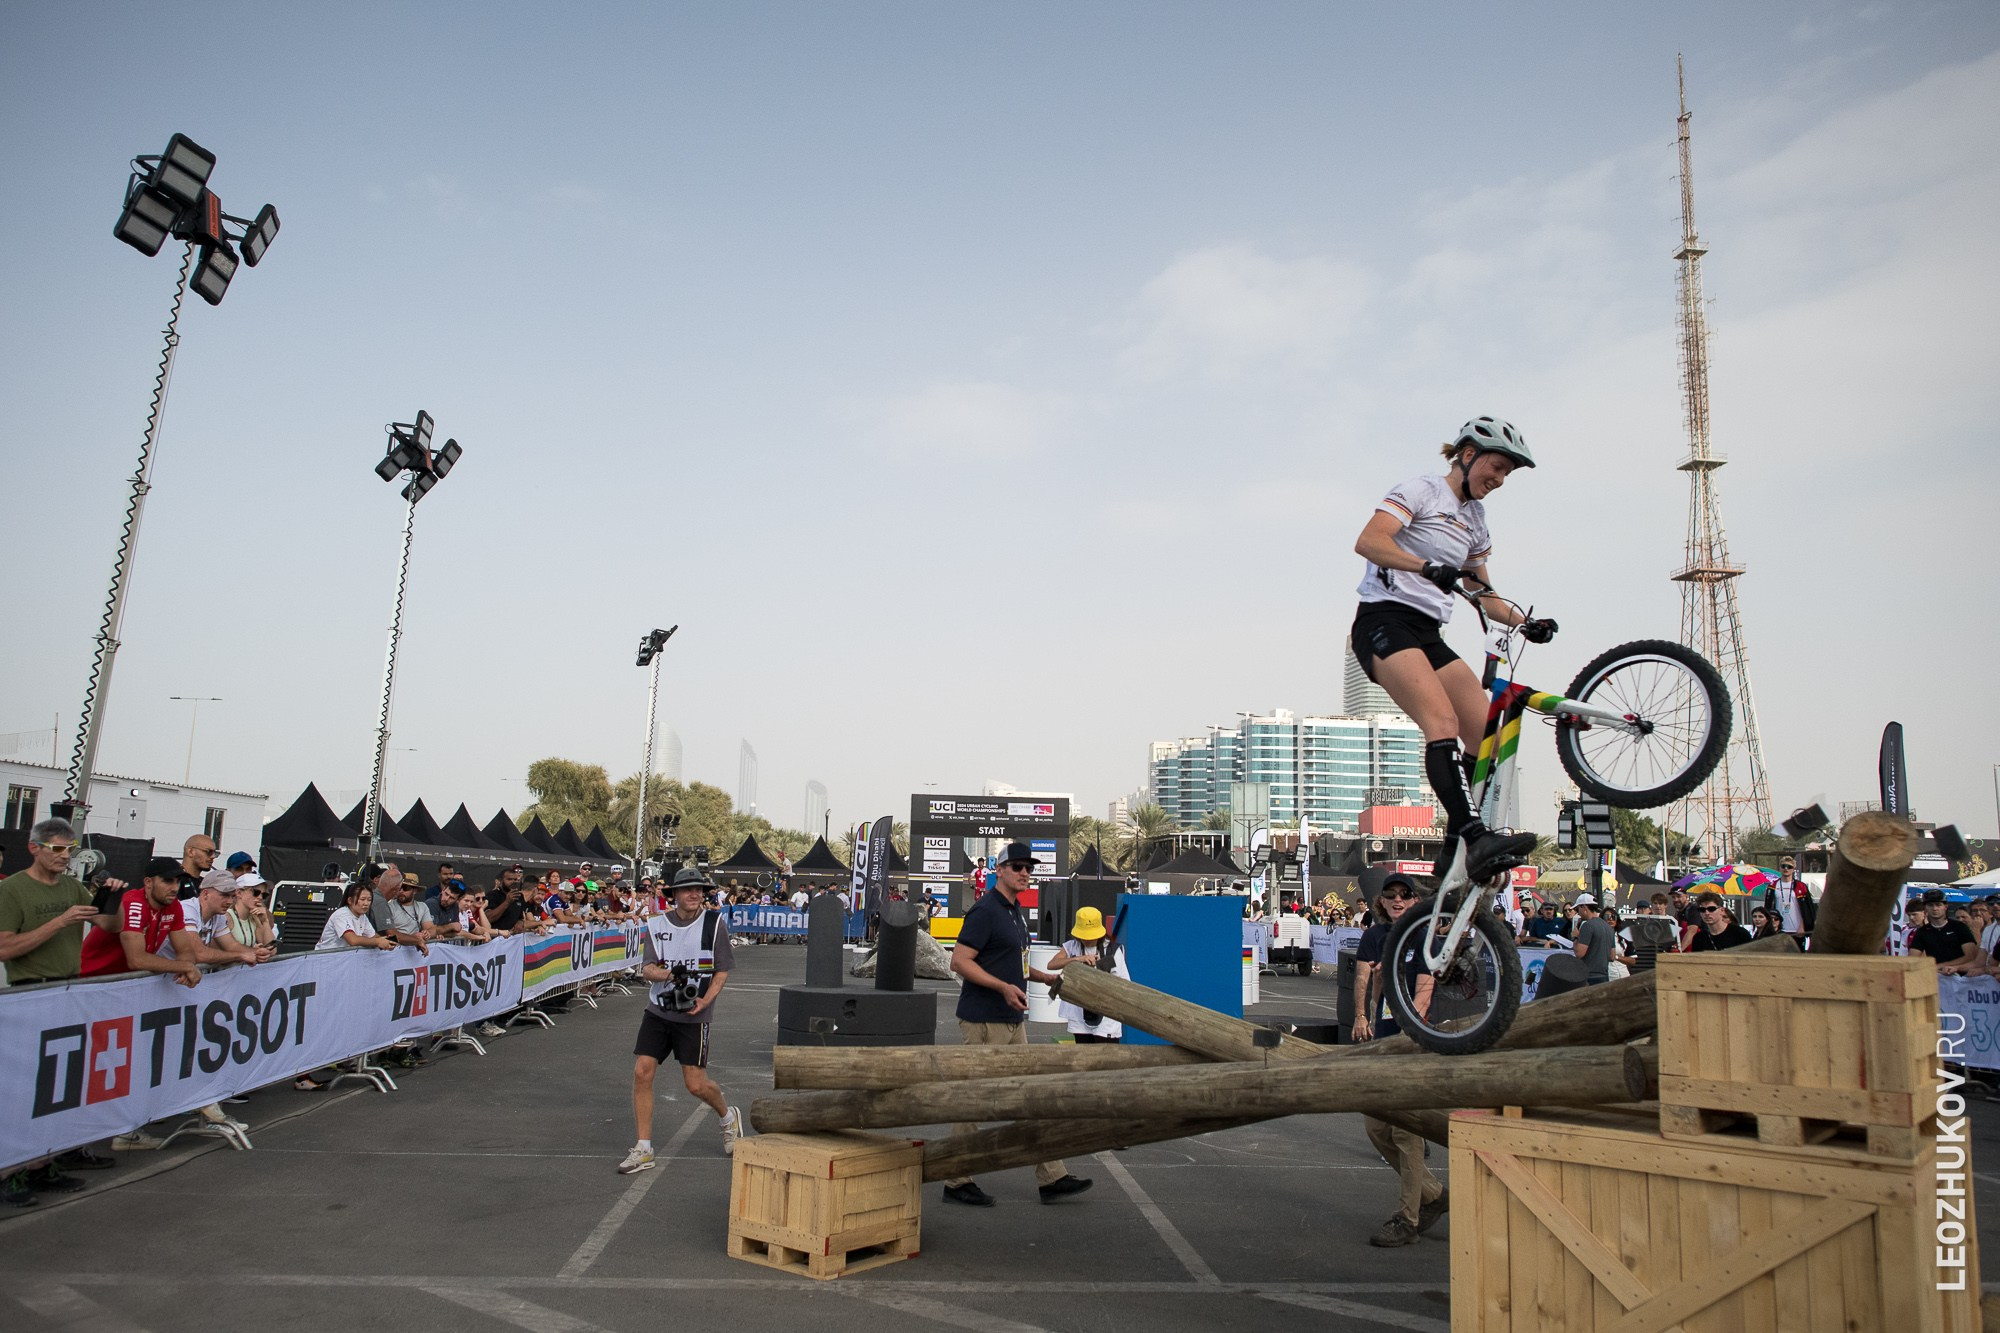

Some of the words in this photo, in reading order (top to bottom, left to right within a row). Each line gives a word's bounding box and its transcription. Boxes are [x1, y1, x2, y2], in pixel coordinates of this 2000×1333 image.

[933, 803, 954, 812] UCI
[978, 826, 1005, 835] START
[1393, 826, 1444, 837] BONJOUR
[929, 839, 947, 847] UCI
[855, 844, 867, 890] UCI
[871, 865, 879, 881] Abu
[571, 931, 594, 971] UCI
[625, 927, 640, 960] UCI
[664, 958, 696, 969] STAFF
[429, 954, 507, 1013] TISSOT
[1968, 990, 1990, 1004] Abu
[140, 981, 317, 1089] TISSOT
